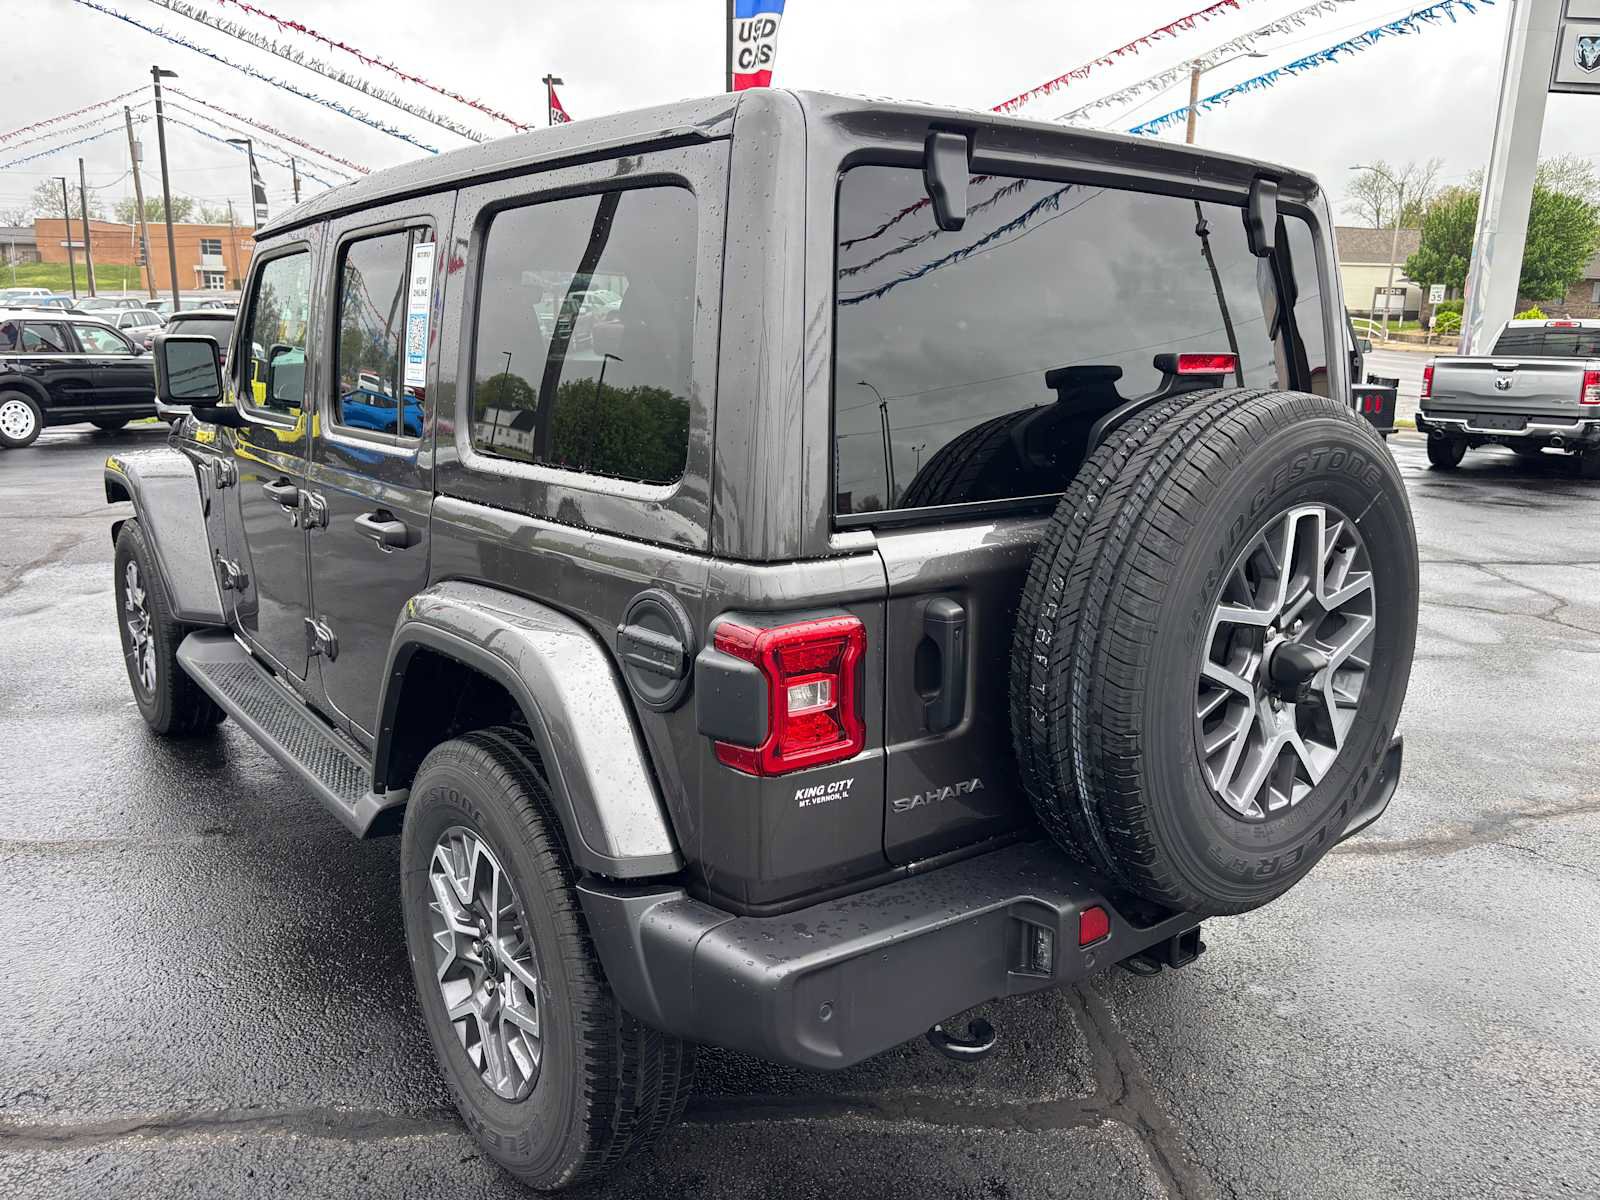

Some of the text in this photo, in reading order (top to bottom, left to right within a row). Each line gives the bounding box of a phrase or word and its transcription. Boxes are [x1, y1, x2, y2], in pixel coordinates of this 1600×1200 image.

[1431, 294, 1443, 302] 35
[794, 778, 855, 801] KING CITY
[892, 778, 984, 813] SAHARA
[799, 799, 812, 808] MT.
[812, 792, 842, 805] VERNON,
